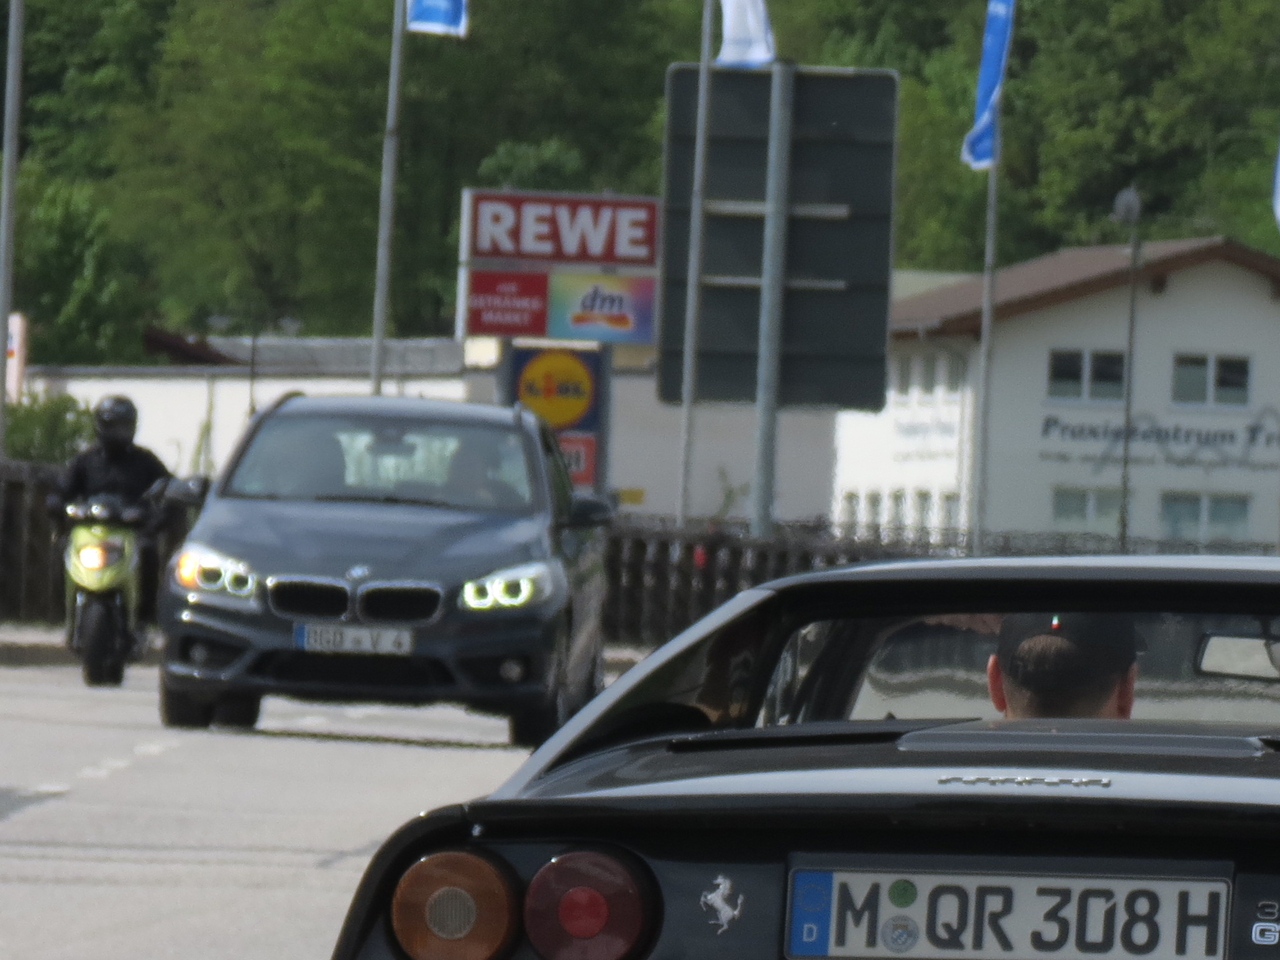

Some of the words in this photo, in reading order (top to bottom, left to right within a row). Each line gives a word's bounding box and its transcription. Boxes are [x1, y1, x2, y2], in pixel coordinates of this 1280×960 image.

[476, 201, 650, 258] REWE
[580, 284, 625, 313] dm
[369, 630, 381, 650] V
[834, 881, 881, 949] M
[926, 884, 1014, 952] QR
[802, 923, 818, 943] D
